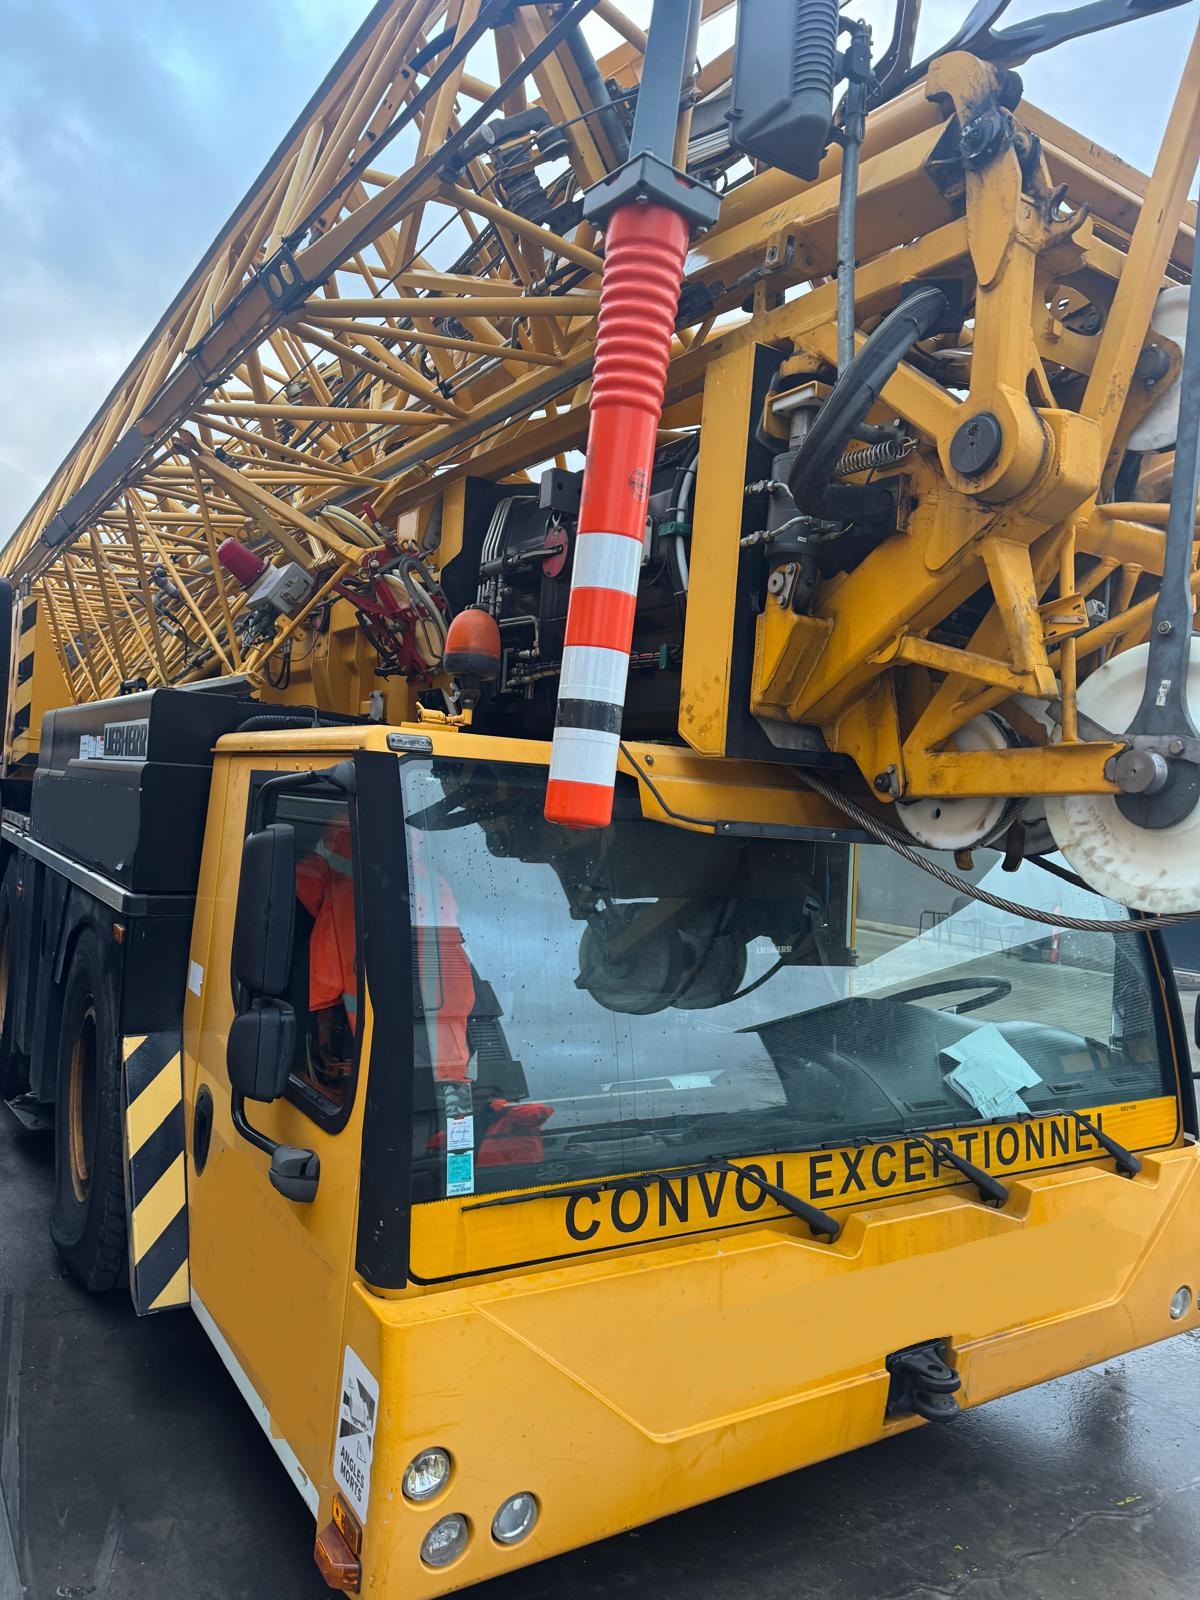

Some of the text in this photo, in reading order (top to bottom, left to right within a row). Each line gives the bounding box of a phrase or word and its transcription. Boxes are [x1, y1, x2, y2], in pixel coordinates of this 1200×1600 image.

[104, 724, 147, 757] LIEBHERR
[565, 1161, 784, 1241] CONVOI
[340, 1445, 364, 1489] ANGLES
[340, 1460, 362, 1503] MORTS
